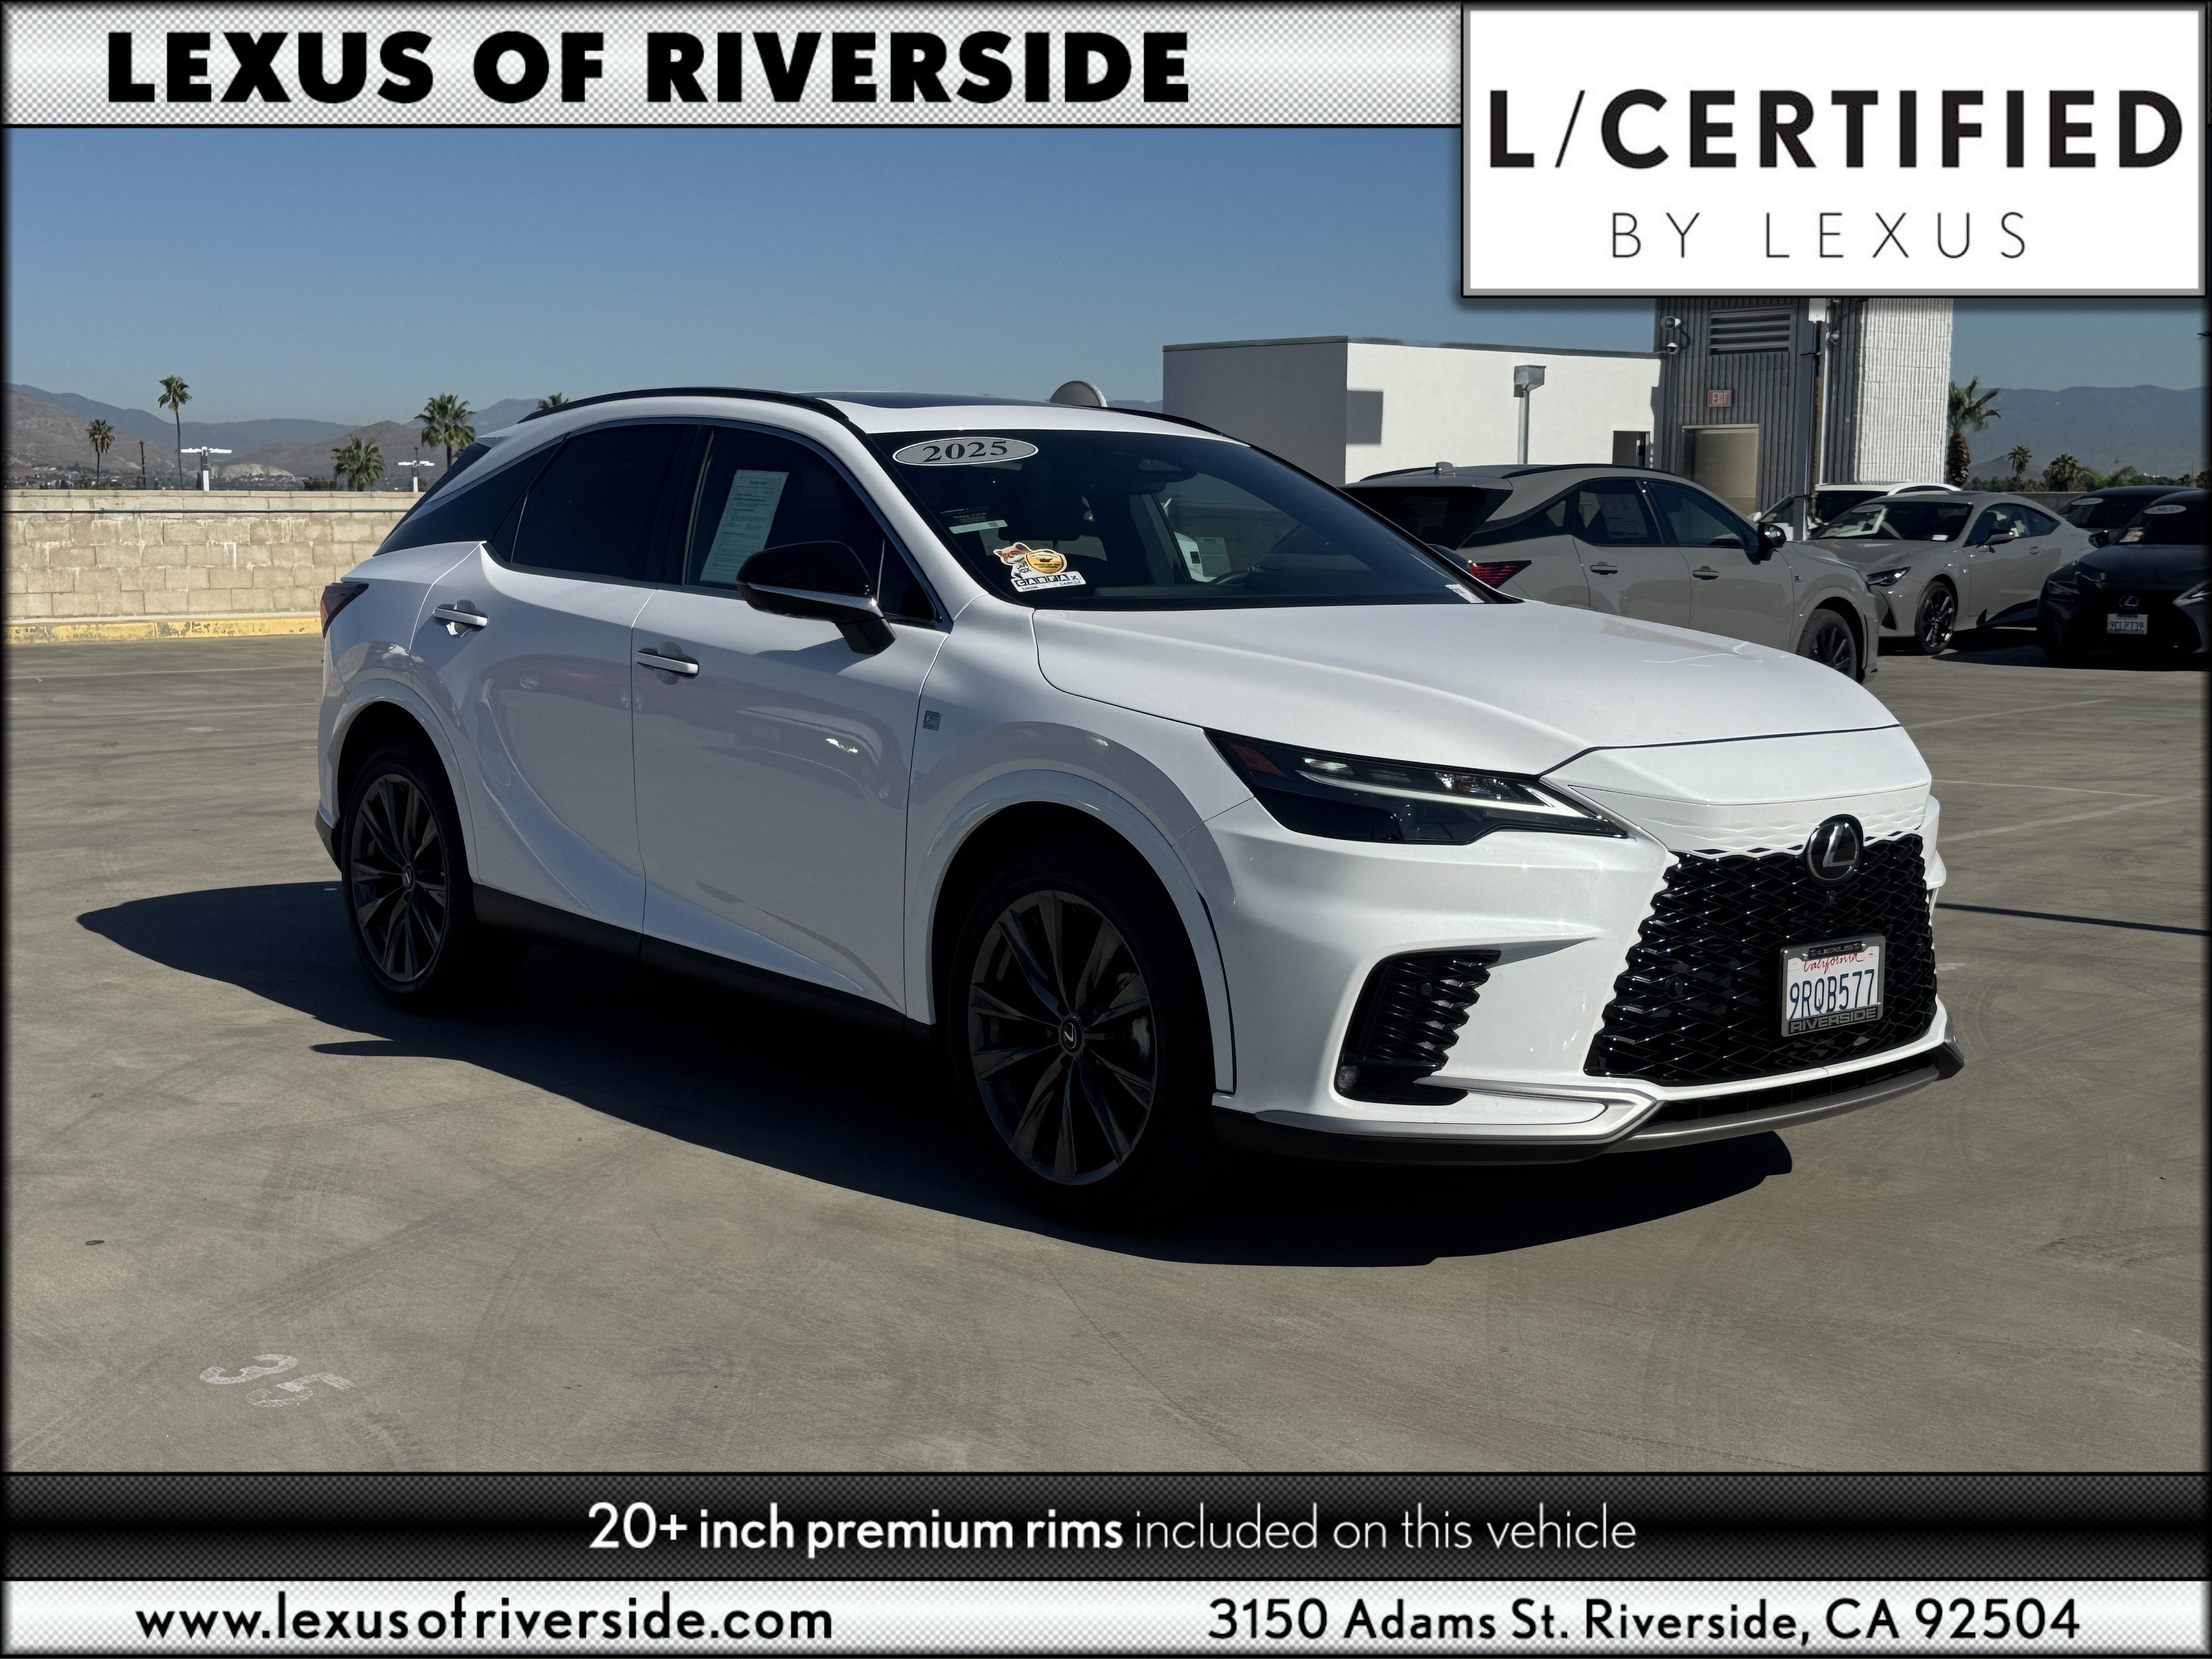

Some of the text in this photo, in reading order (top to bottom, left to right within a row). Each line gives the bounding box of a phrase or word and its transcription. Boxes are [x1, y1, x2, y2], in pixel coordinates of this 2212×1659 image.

[923, 441, 1008, 462] 2025
[1803, 952, 1864, 975] California
[1790, 969, 1875, 1020] 9RQB577
[1790, 1007, 1877, 1033] RIVERSIDE
